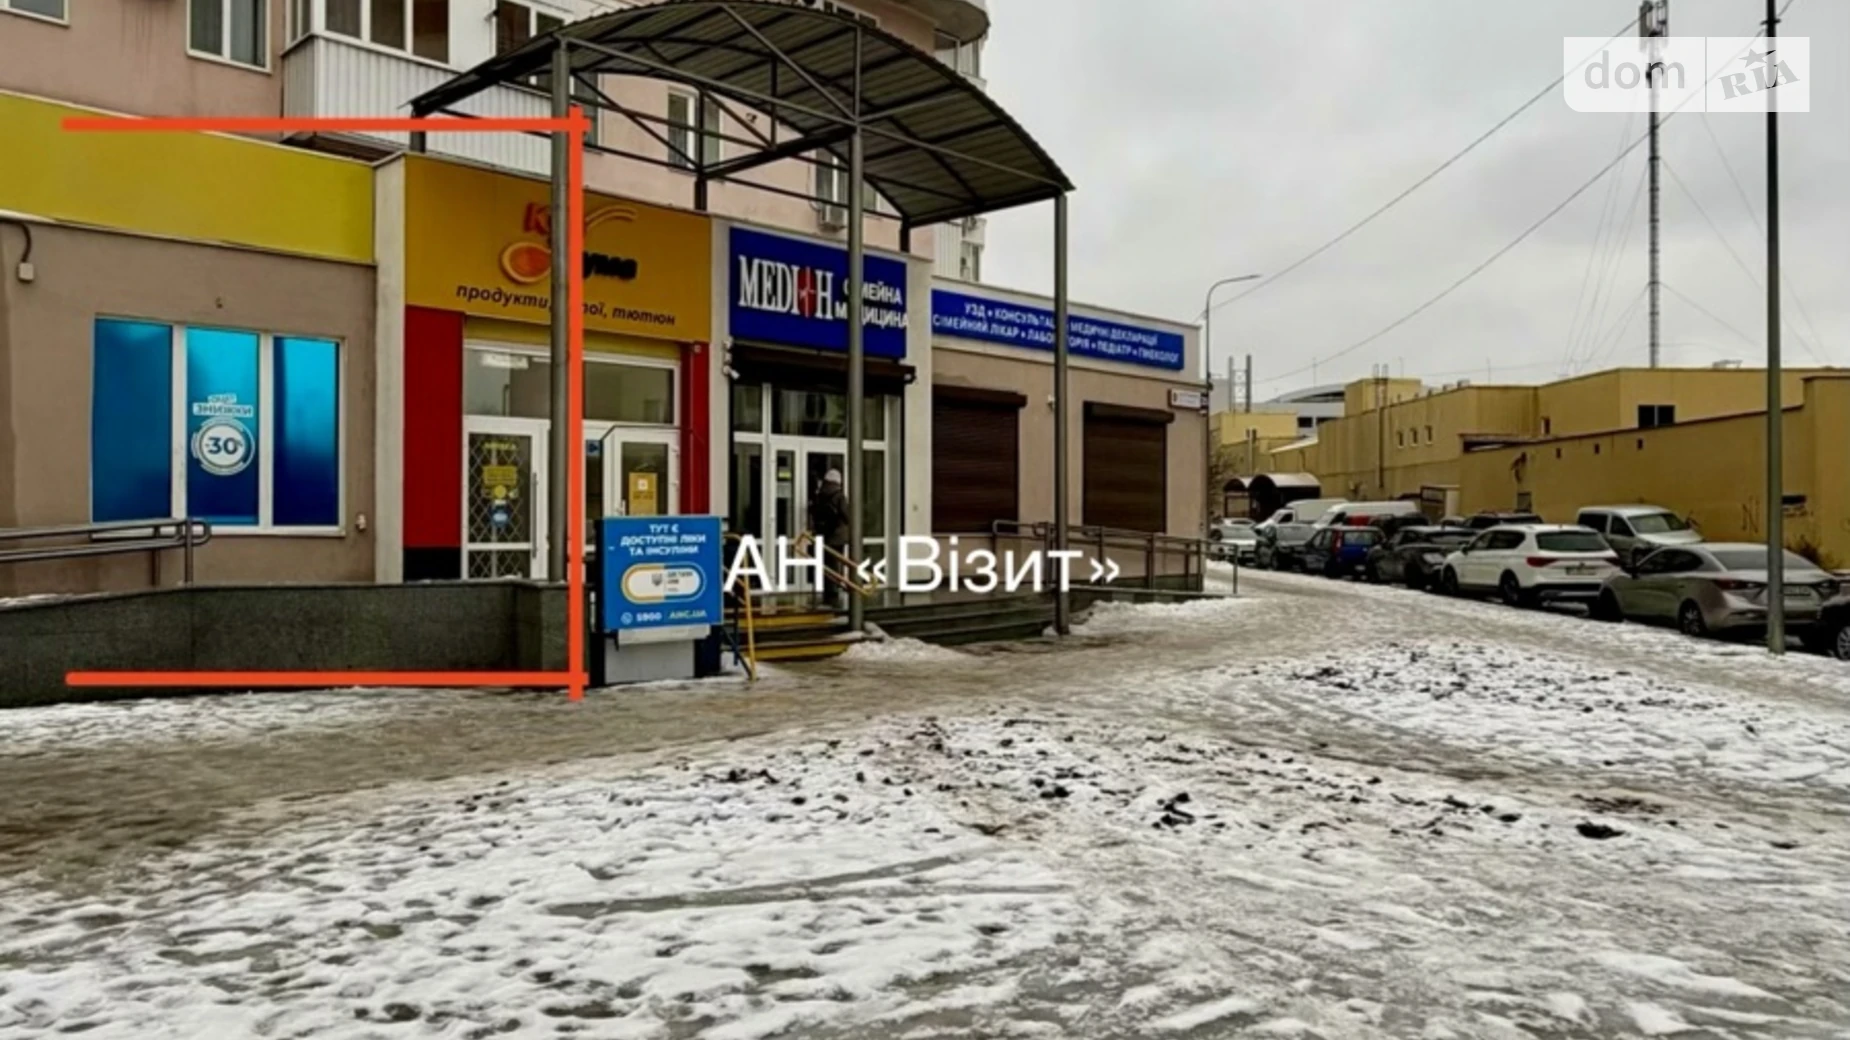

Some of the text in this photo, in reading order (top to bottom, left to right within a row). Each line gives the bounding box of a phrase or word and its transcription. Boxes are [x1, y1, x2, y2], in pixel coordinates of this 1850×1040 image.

[612, 306, 675, 326] тютюн
[964, 302, 986, 320] УЗД
[932, 314, 989, 333] СІМЕЙНИЙ
[990, 323, 1019, 338] ЛІКАР
[648, 523, 670, 533] ТУТ
[620, 534, 678, 547] ДОСТУПНІ
[629, 546, 644, 556] ТА
